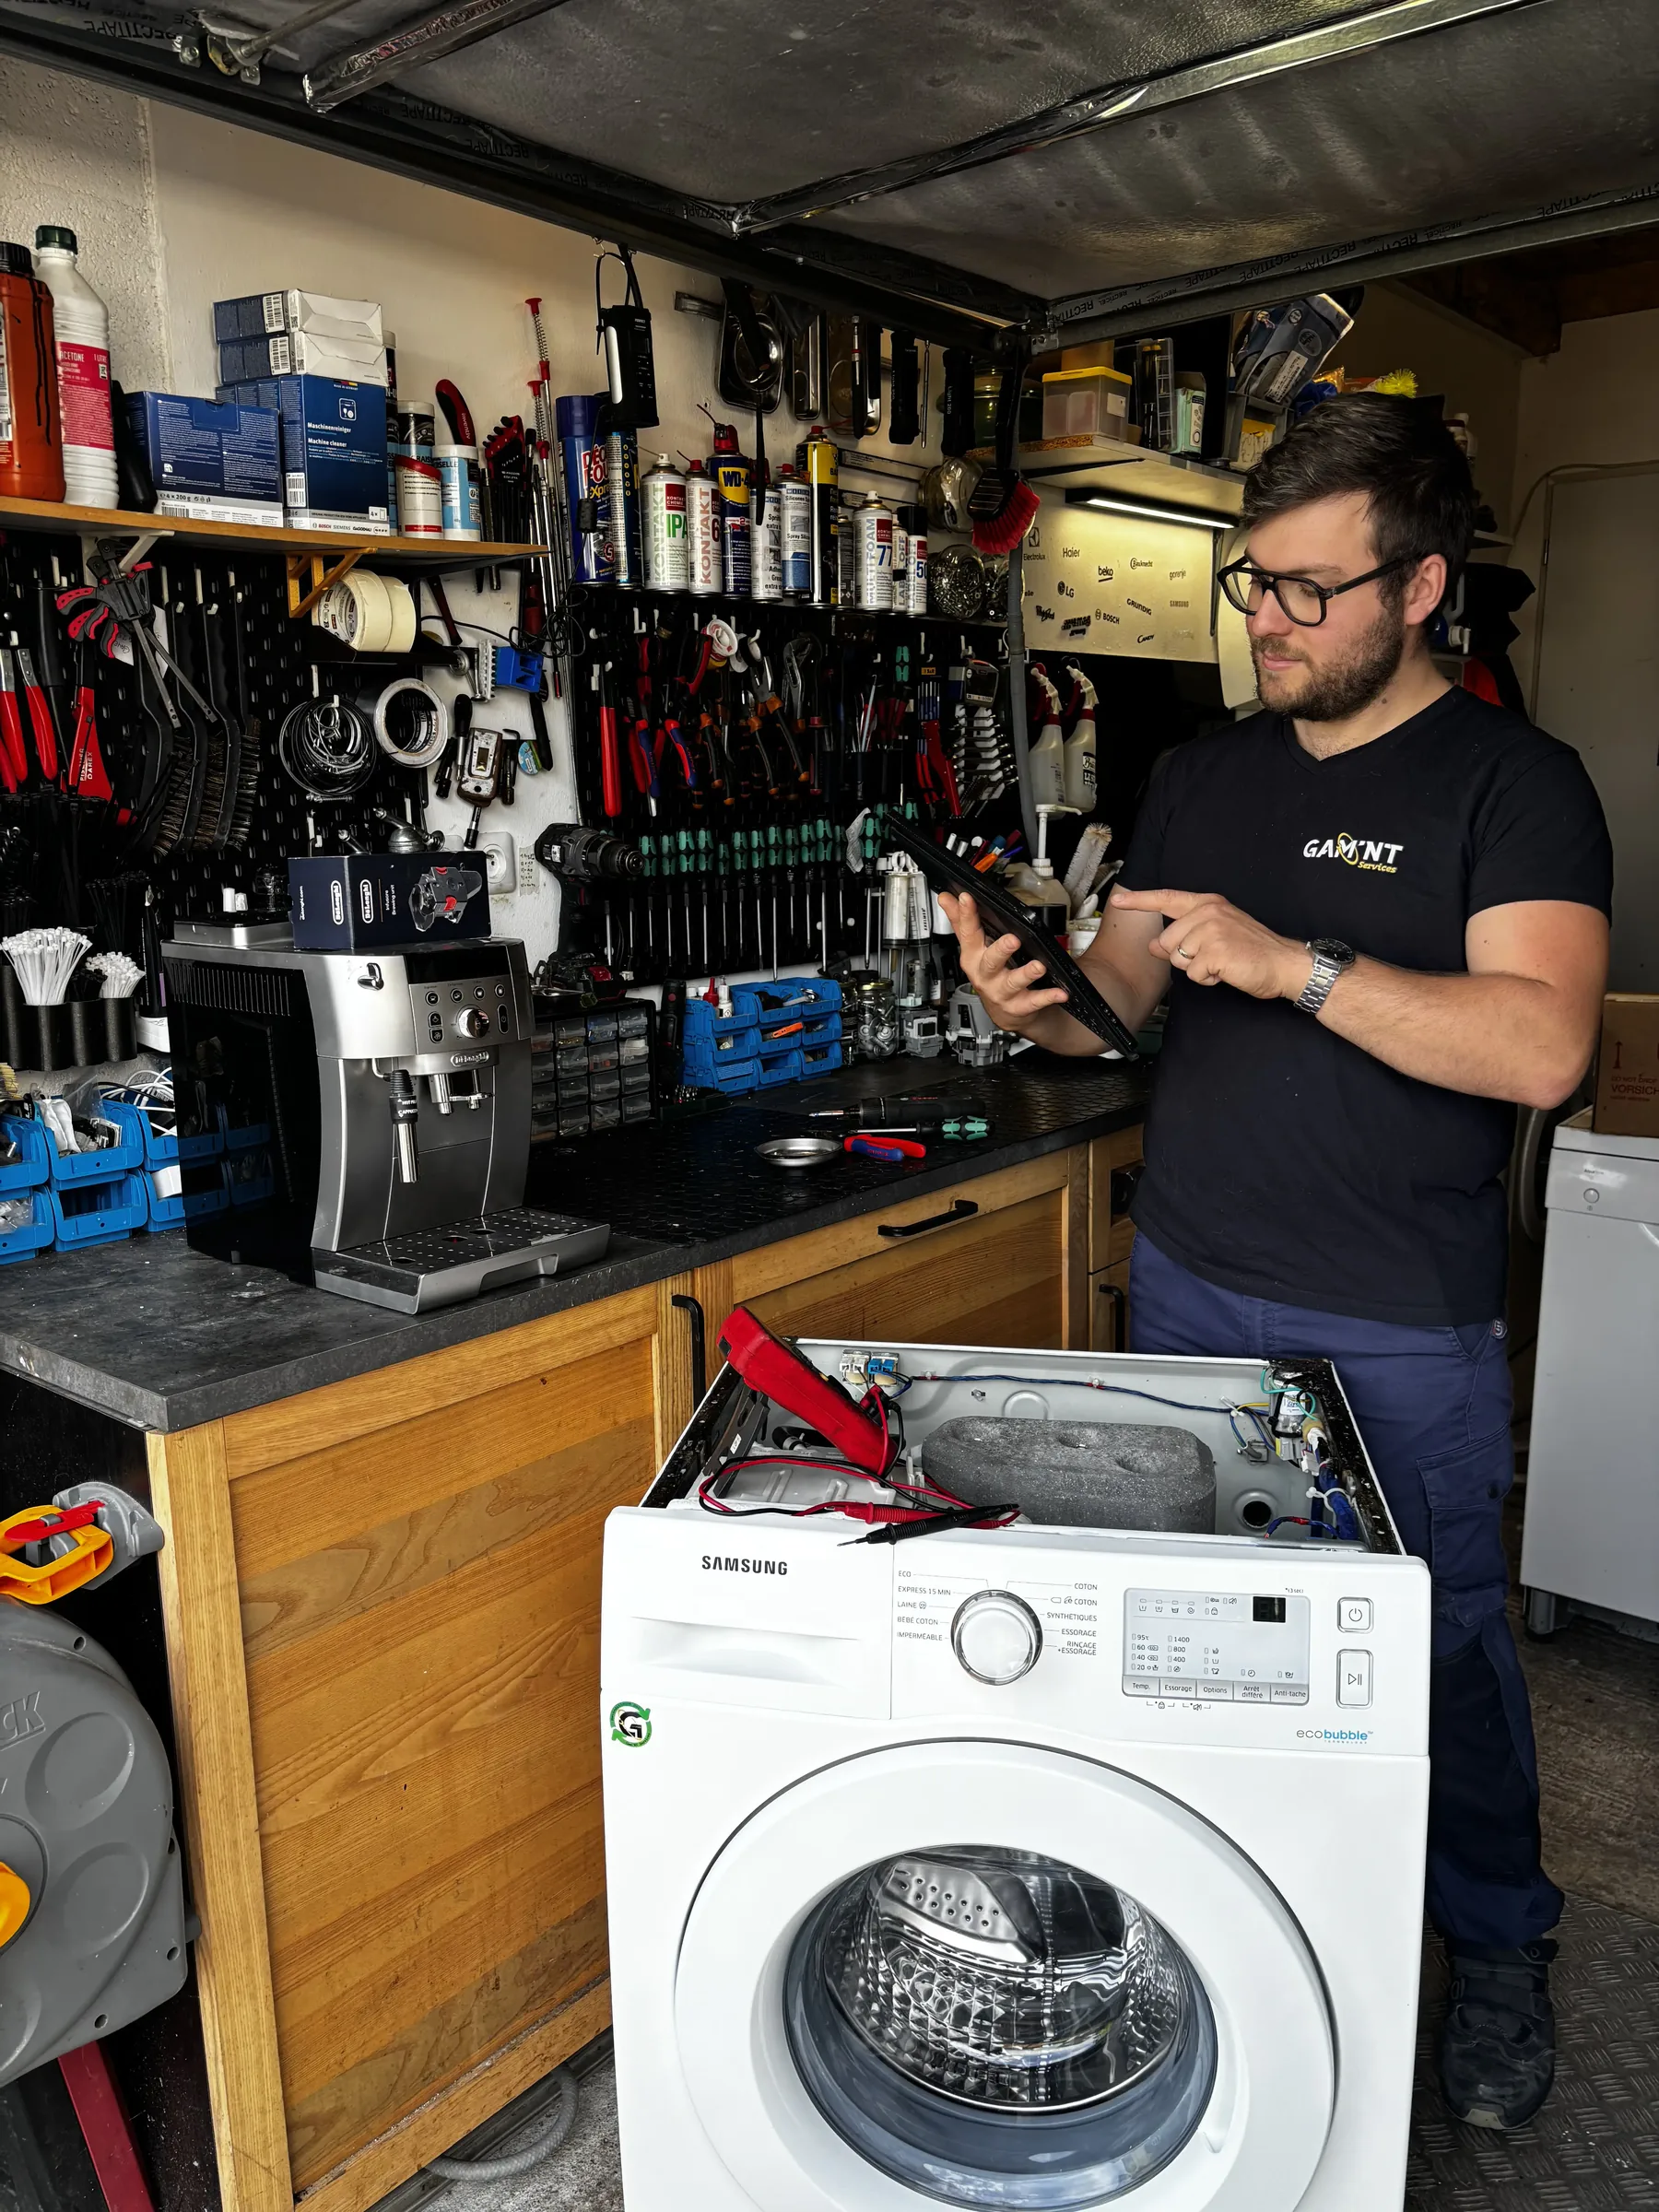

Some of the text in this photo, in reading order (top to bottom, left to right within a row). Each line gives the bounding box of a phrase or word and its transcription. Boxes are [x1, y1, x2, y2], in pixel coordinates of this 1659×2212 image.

[308, 422, 351, 433] Maschinenreiniger
[308, 438, 347, 448] Machine cleaner
[653, 483, 665, 582] KONTAKT
[700, 488, 712, 584] KONTAKT
[1023, 553, 1046, 561] Electrolux
[1063, 547, 1080, 558] Haier
[1131, 559, 1153, 569] Bauknecht
[1098, 565, 1113, 577] beko
[1170, 569, 1186, 581] gorenje
[1065, 586, 1075, 598] LG
[1126, 598, 1152, 616] GRUNDIG
[1170, 600, 1189, 608] SAMSUNG
[1102, 612, 1120, 625] BOSCH
[701, 1555, 788, 1575] SAMSUNG
[898, 1585, 926, 1594] EXPRESS
[915, 1618, 938, 1626] COTON
[1061, 1628, 1097, 1637] ESSORAGE
[1133, 1682, 1151, 1690] Temp.
[1164, 1684, 1193, 1692] Essorage
[1203, 1686, 1228, 1694] Options
